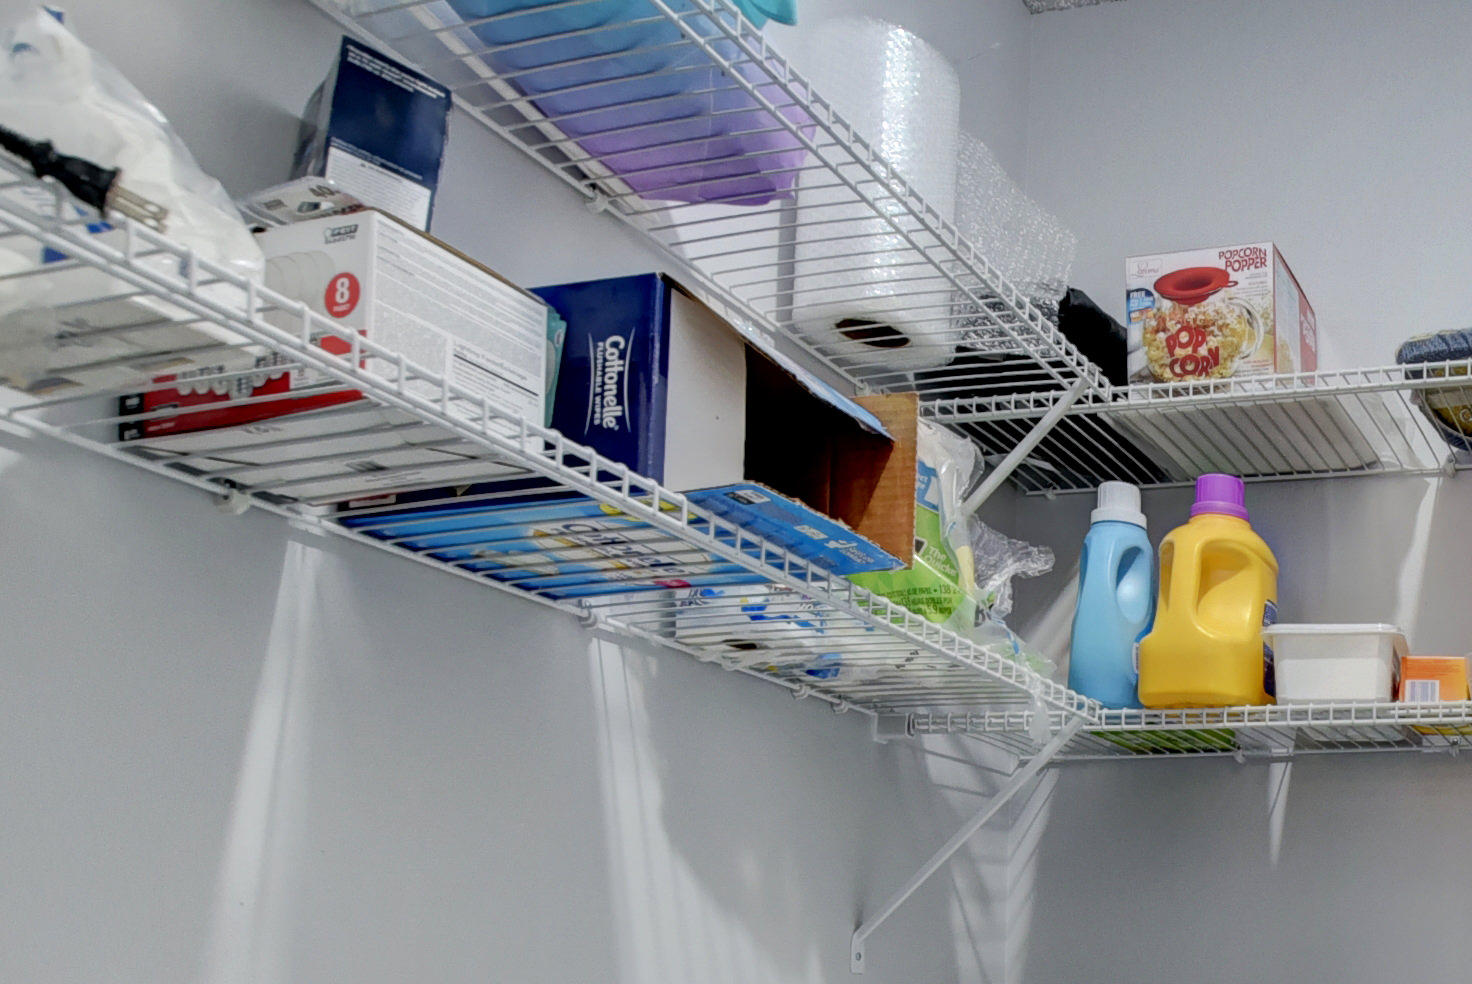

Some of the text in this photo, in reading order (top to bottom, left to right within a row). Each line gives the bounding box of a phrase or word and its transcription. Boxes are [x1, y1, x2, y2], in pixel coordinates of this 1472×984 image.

[1218, 246, 1267, 261] POPCORN
[1225, 256, 1267, 272] POPPER
[335, 277, 349, 303] 8
[1165, 325, 1207, 357] POP
[1169, 346, 1220, 377] CORN
[602, 335, 625, 429] Cottonelle
